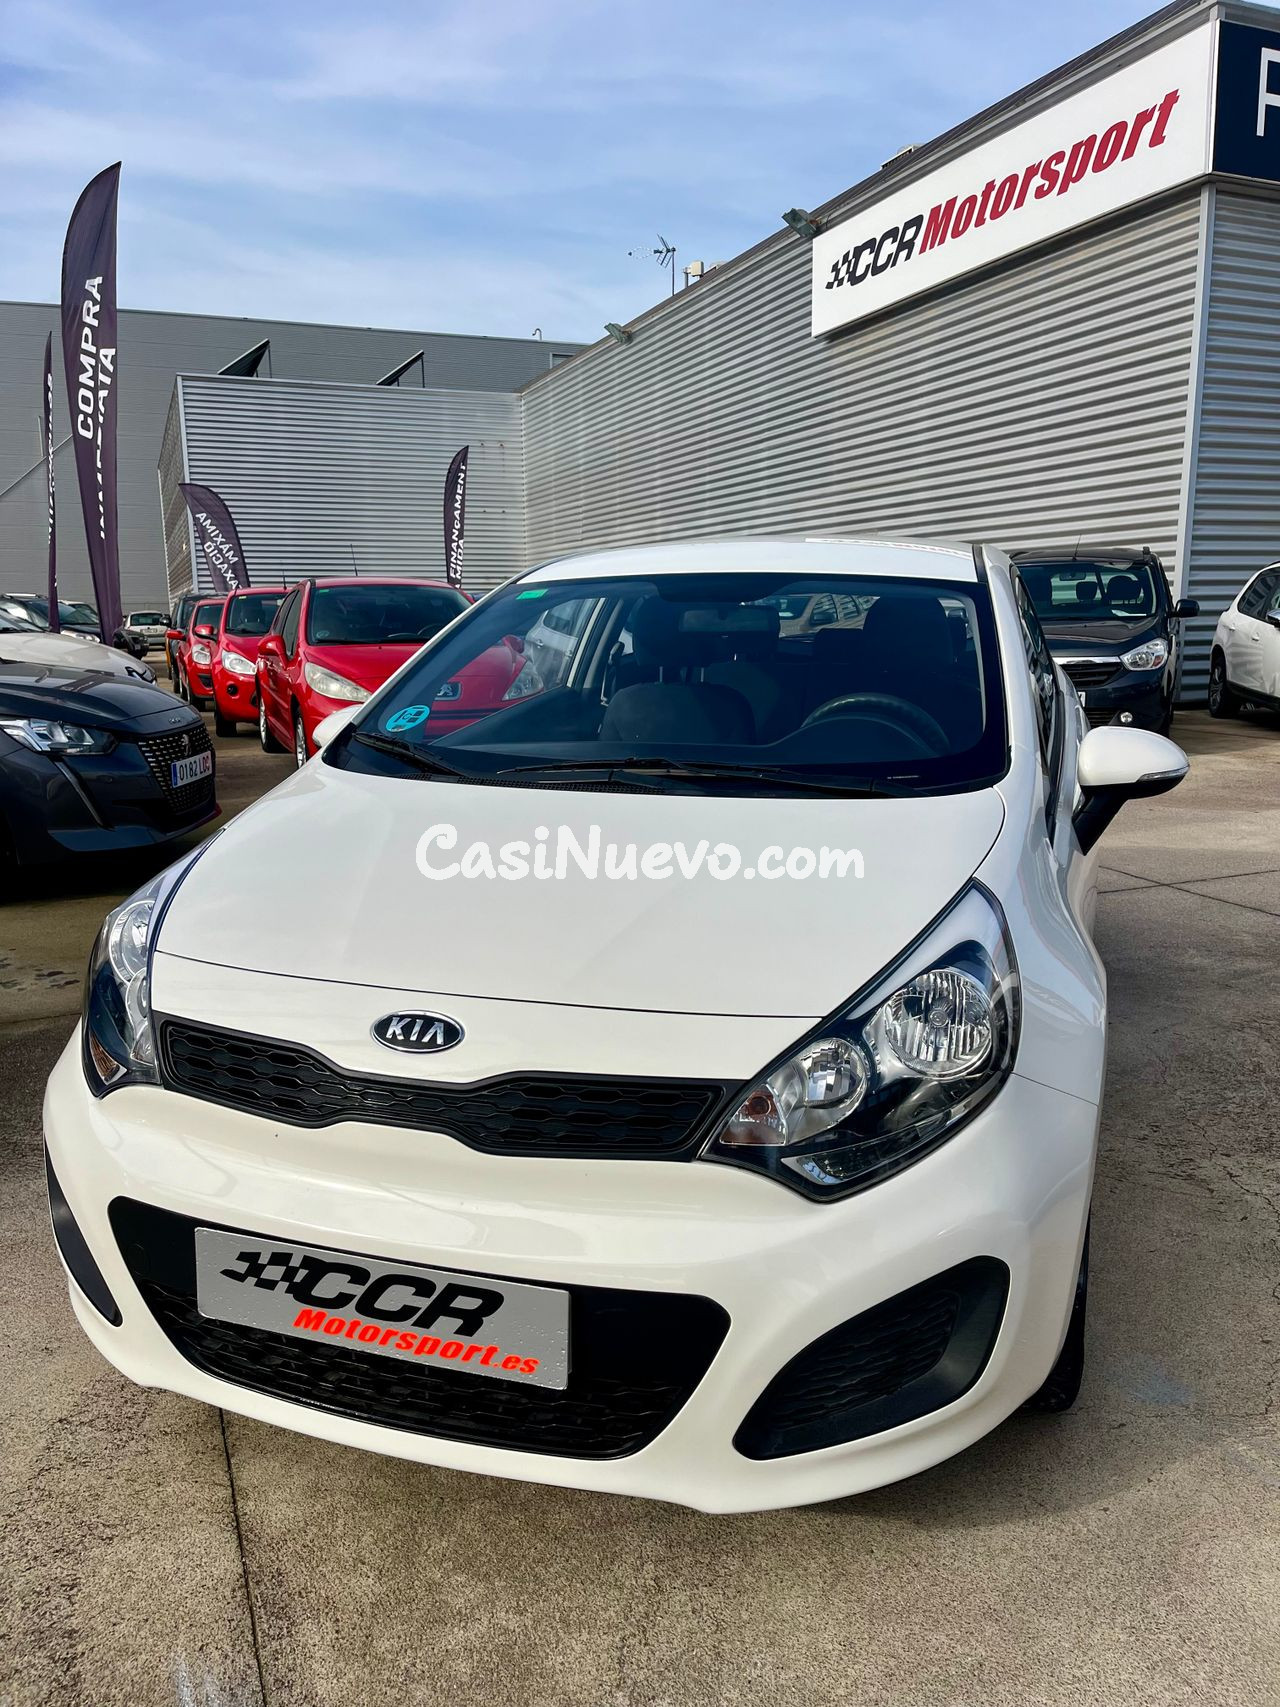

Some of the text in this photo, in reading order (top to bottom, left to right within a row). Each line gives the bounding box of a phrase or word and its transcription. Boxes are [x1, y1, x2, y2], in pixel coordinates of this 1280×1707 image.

[918, 88, 1180, 255] Motorsport
[77, 276, 103, 440] COMPRA
[179, 761, 198, 781] 0182
[385, 1016, 445, 1046] KIA
[293, 1254, 505, 1338] CCR
[293, 1307, 541, 1375] Motorsport.es
